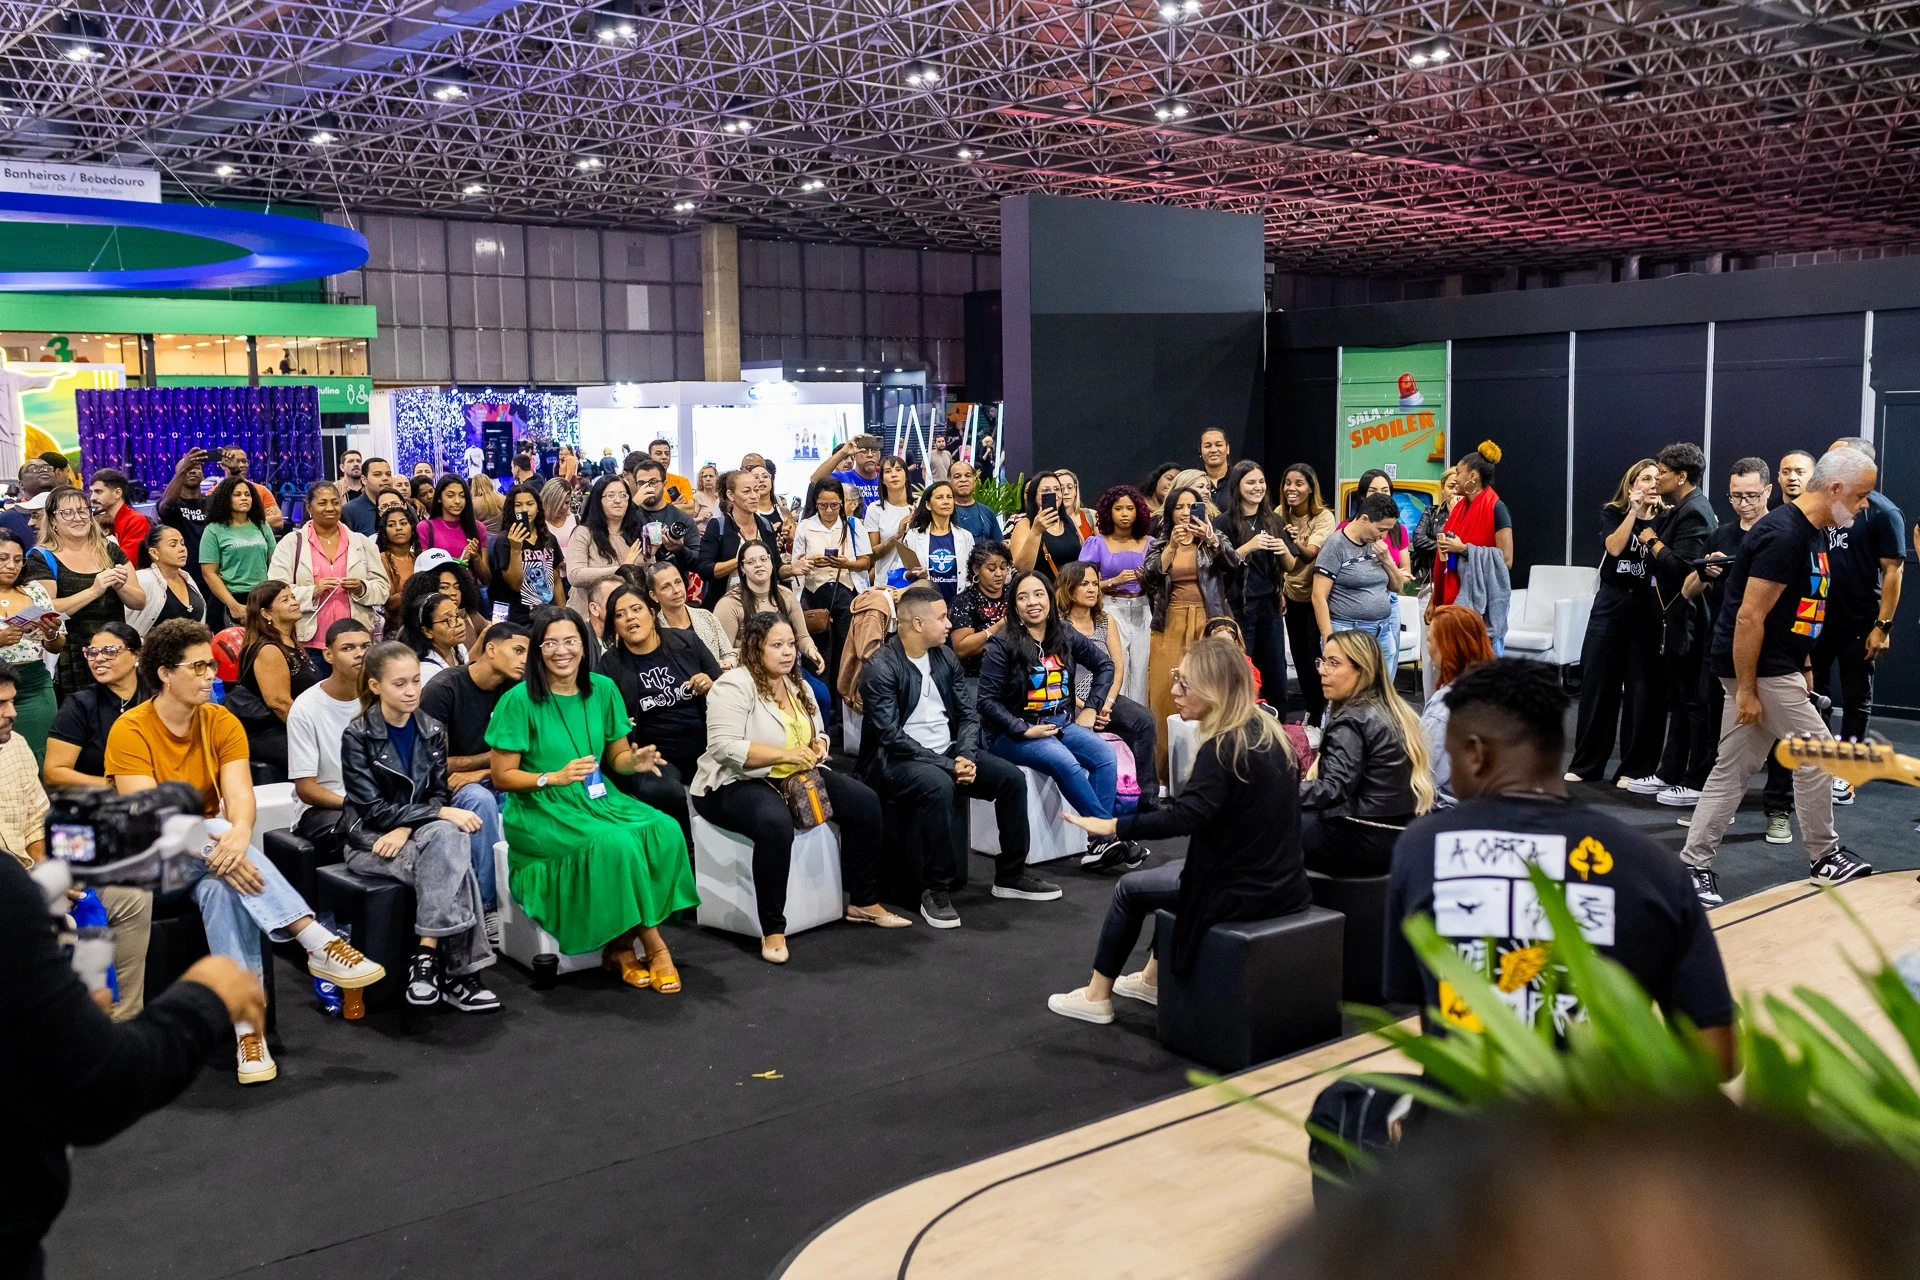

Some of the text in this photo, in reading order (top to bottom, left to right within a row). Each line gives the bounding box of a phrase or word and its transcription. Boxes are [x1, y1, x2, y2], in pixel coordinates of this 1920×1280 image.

[4, 168, 145, 187] Banheiros / Bebedouro
[29, 182, 49, 191] Toilet
[57, 184, 89, 195] Drinking
[91, 187, 123, 196] Fountain
[1347, 408, 1395, 428] SALA de
[1350, 410, 1435, 449] SPOILER
[639, 666, 676, 690] MK
